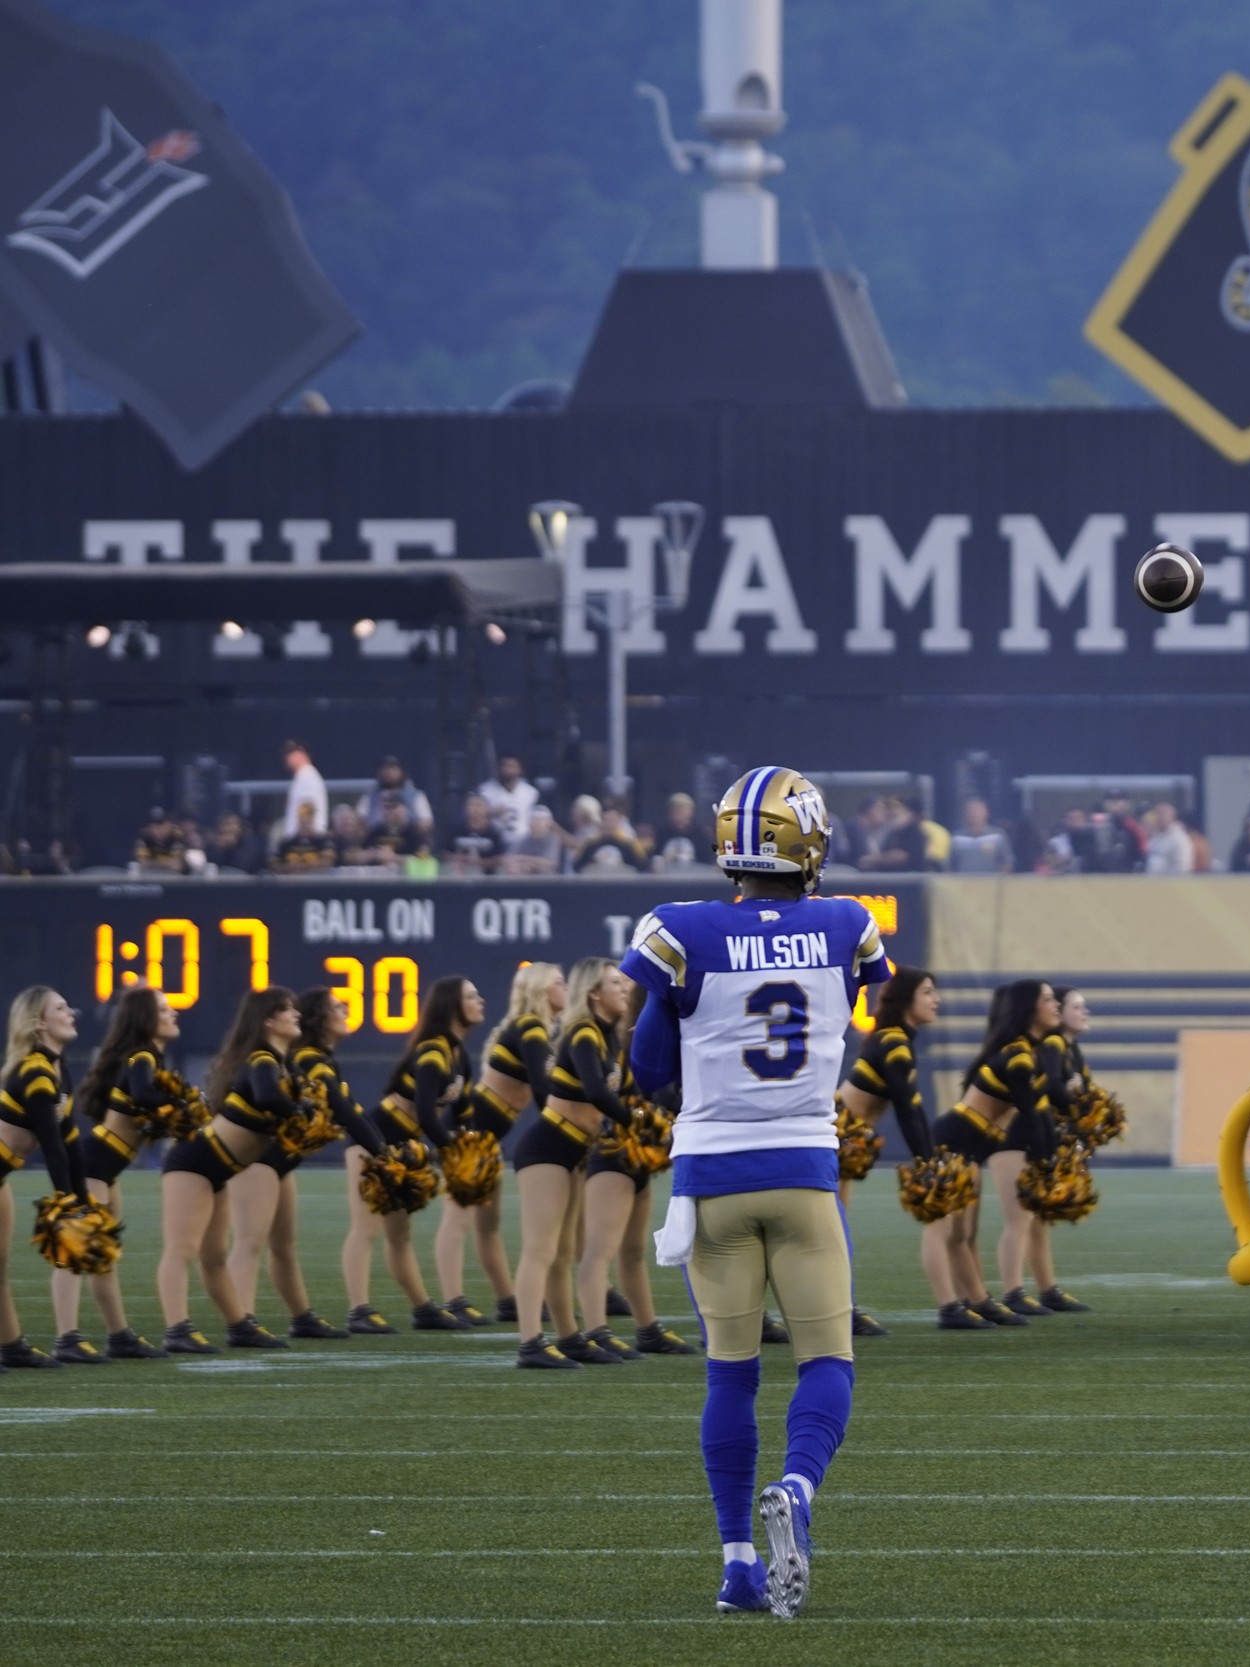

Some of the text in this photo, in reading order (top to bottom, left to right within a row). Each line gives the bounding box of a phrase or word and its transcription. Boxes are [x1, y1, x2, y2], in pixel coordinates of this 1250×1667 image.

[784, 789, 824, 835] W
[726, 860, 776, 870] BLUE BOMBERS
[304, 898, 435, 943] BALL ON
[472, 898, 552, 942] QTR
[726, 932, 829, 971] WILSON
[324, 957, 419, 1034] 30
[742, 979, 809, 1081] 3
